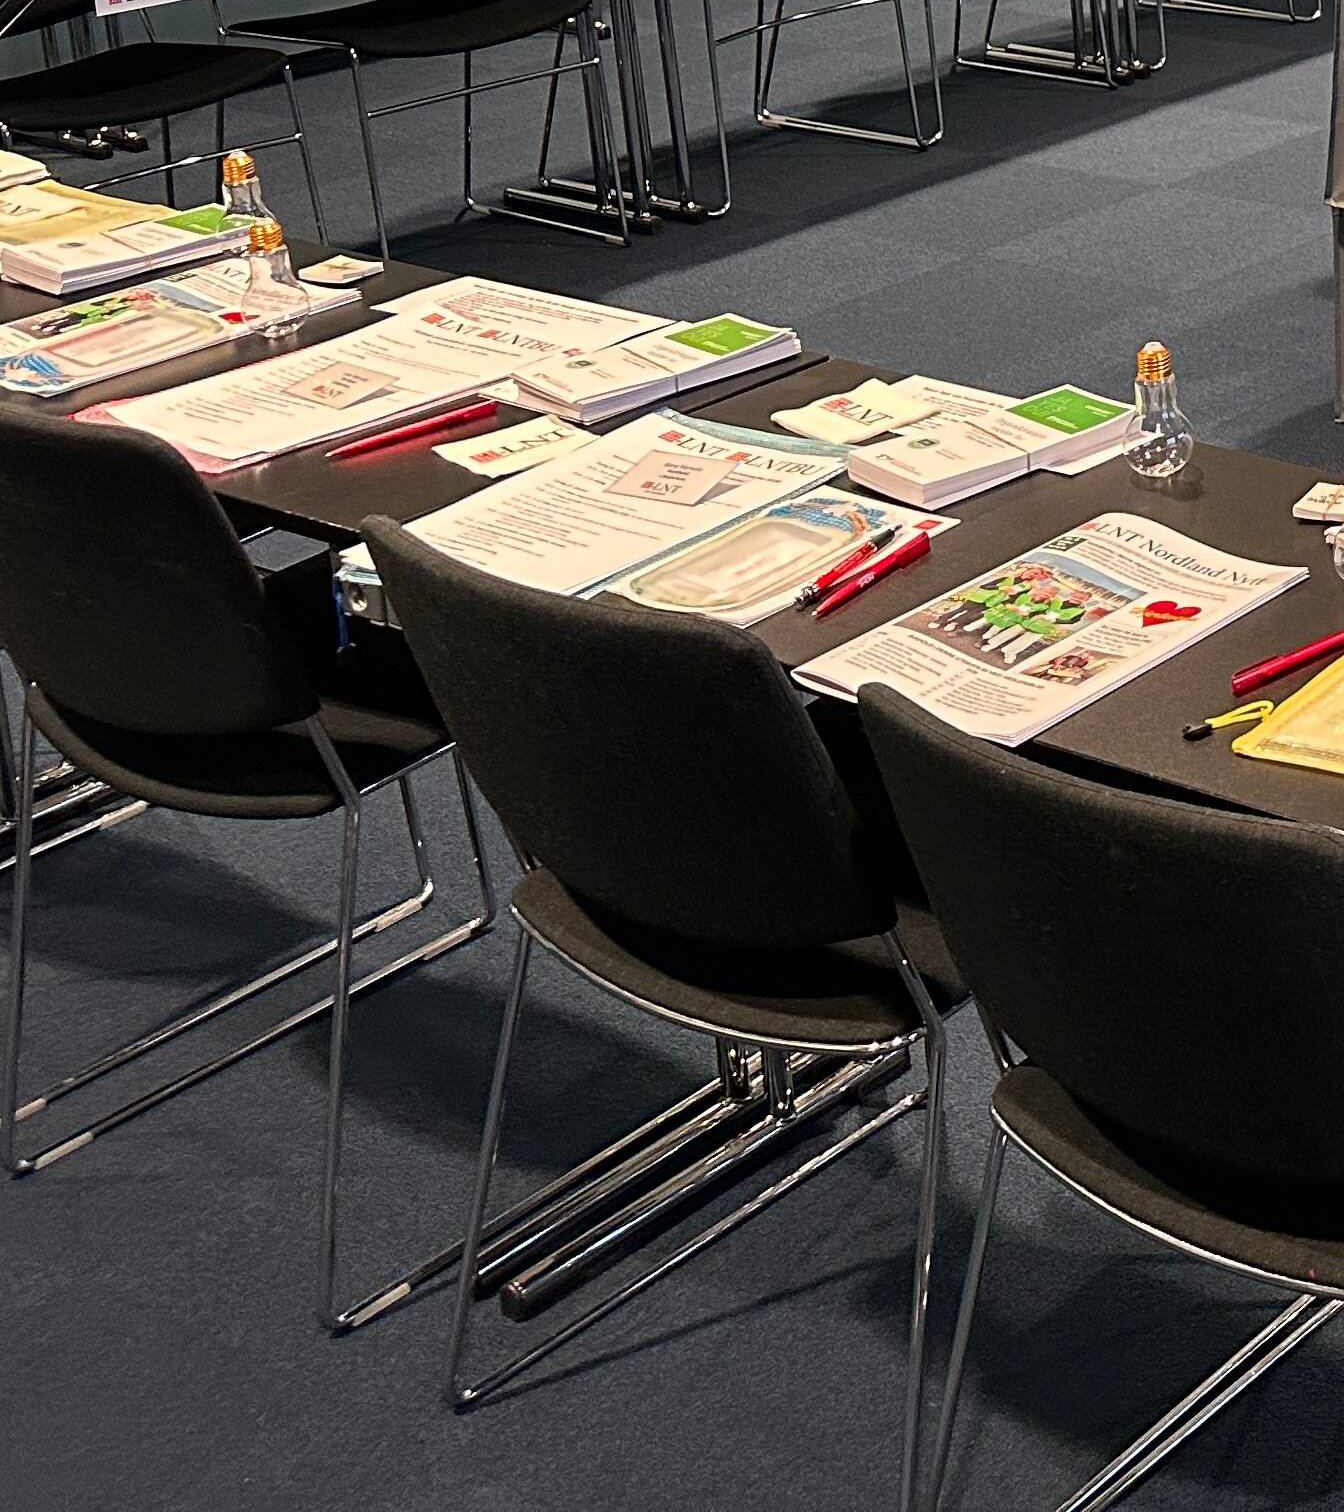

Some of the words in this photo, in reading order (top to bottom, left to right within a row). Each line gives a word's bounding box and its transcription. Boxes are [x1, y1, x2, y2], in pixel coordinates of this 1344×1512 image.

[437, 320, 483, 335] LNT
[494, 332, 564, 352] LNTBU
[838, 404, 894, 424] LNT
[499, 428, 567, 454] LNT
[677, 437, 731, 457] LNT
[743, 456, 824, 476] LNTBU
[652, 481, 686, 494] LNT
[1095, 523, 1145, 543] LNT
[1138, 539, 1229, 579] Nordland
[1223, 571, 1269, 587] Nytt
